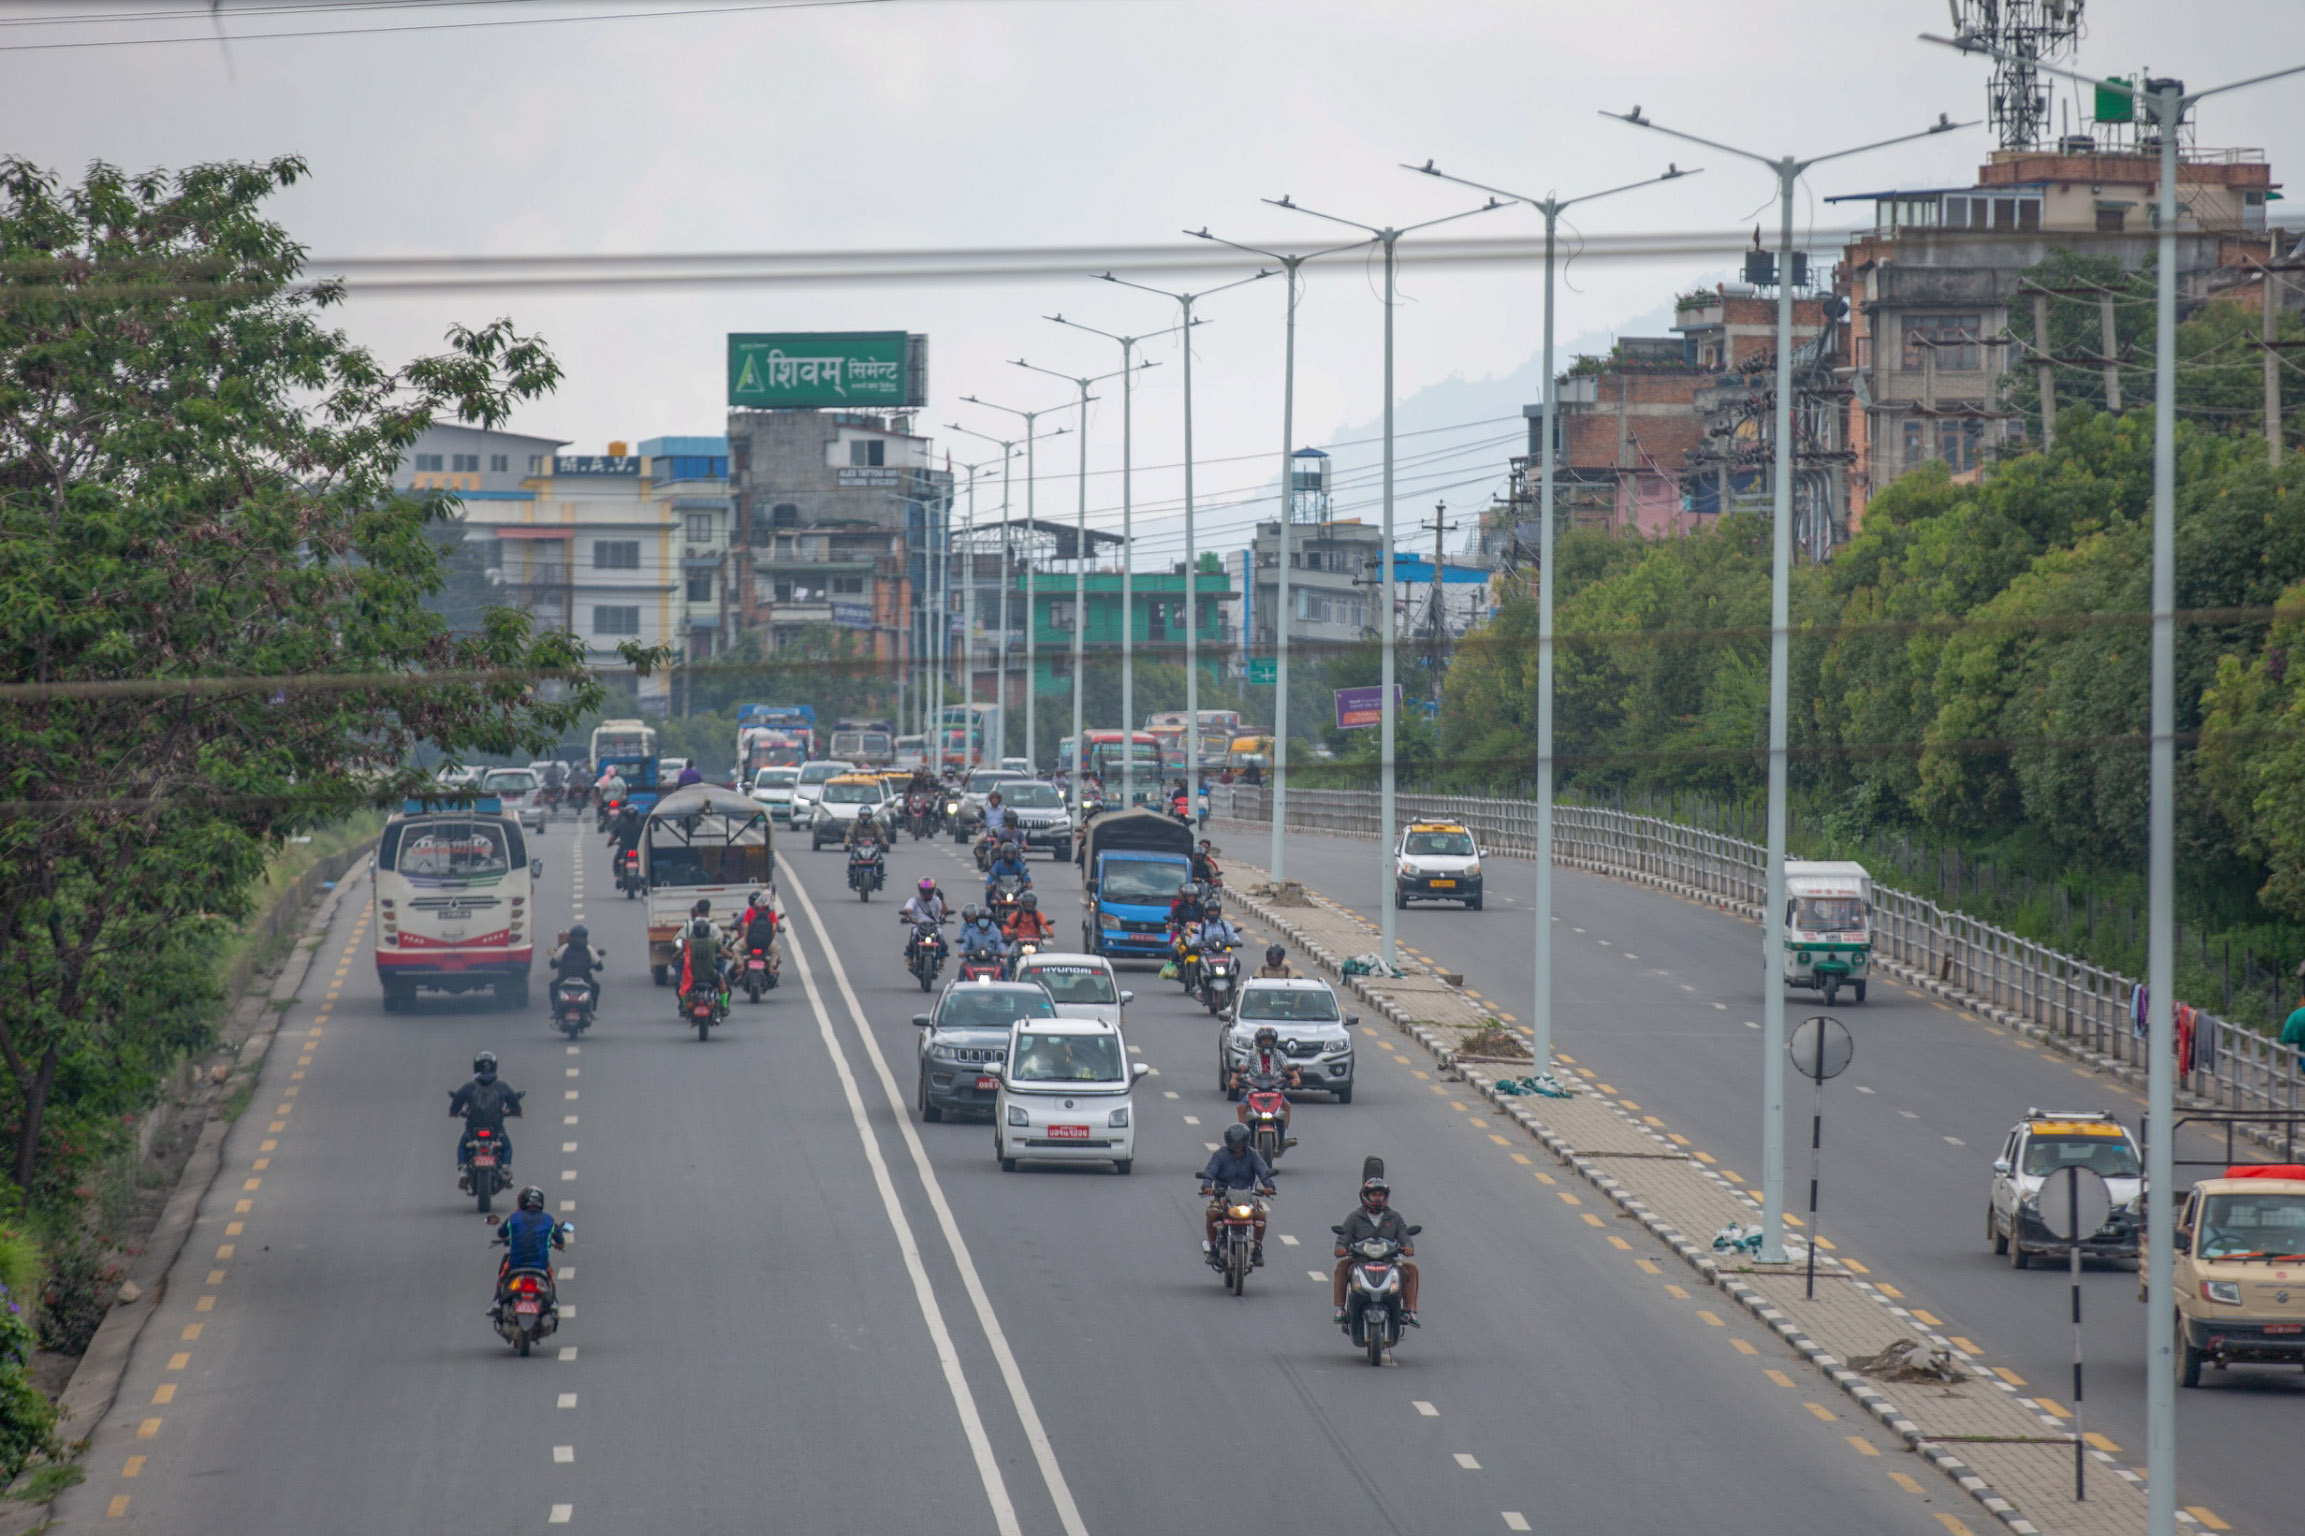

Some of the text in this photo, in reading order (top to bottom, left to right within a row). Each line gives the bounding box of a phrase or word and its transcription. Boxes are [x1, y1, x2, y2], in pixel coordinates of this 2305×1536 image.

[767, 348, 899, 397] शिवम् सिमेन्ट
[1042, 966, 1092, 975] HYUNDAI
